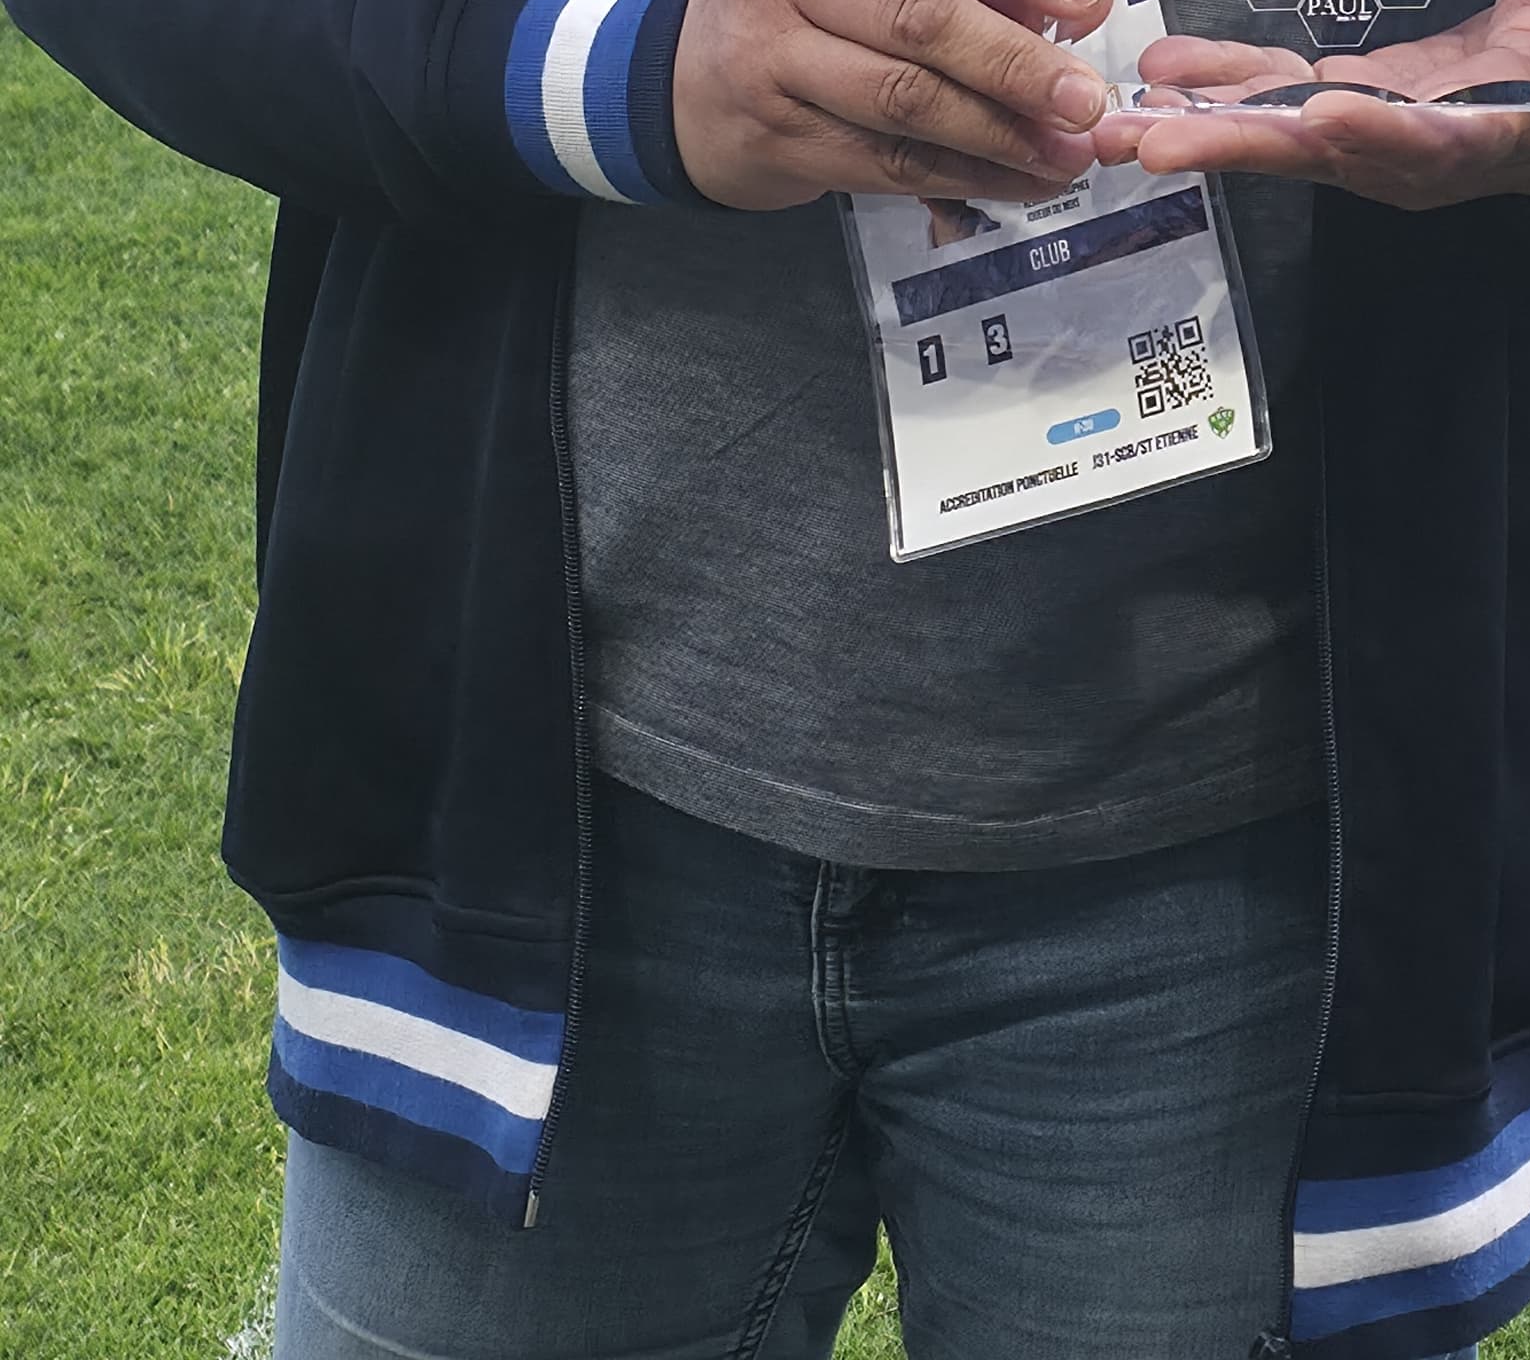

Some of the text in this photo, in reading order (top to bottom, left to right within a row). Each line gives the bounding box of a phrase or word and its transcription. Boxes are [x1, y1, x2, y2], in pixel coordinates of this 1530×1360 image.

[1029, 239, 1071, 271] CLUB
[923, 324, 1008, 374] 1 3
[940, 482, 1015, 514] ACCREDITATION
[1016, 461, 1079, 493] PONCTUELLE
[1155, 424, 1199, 451] ETIENNE
